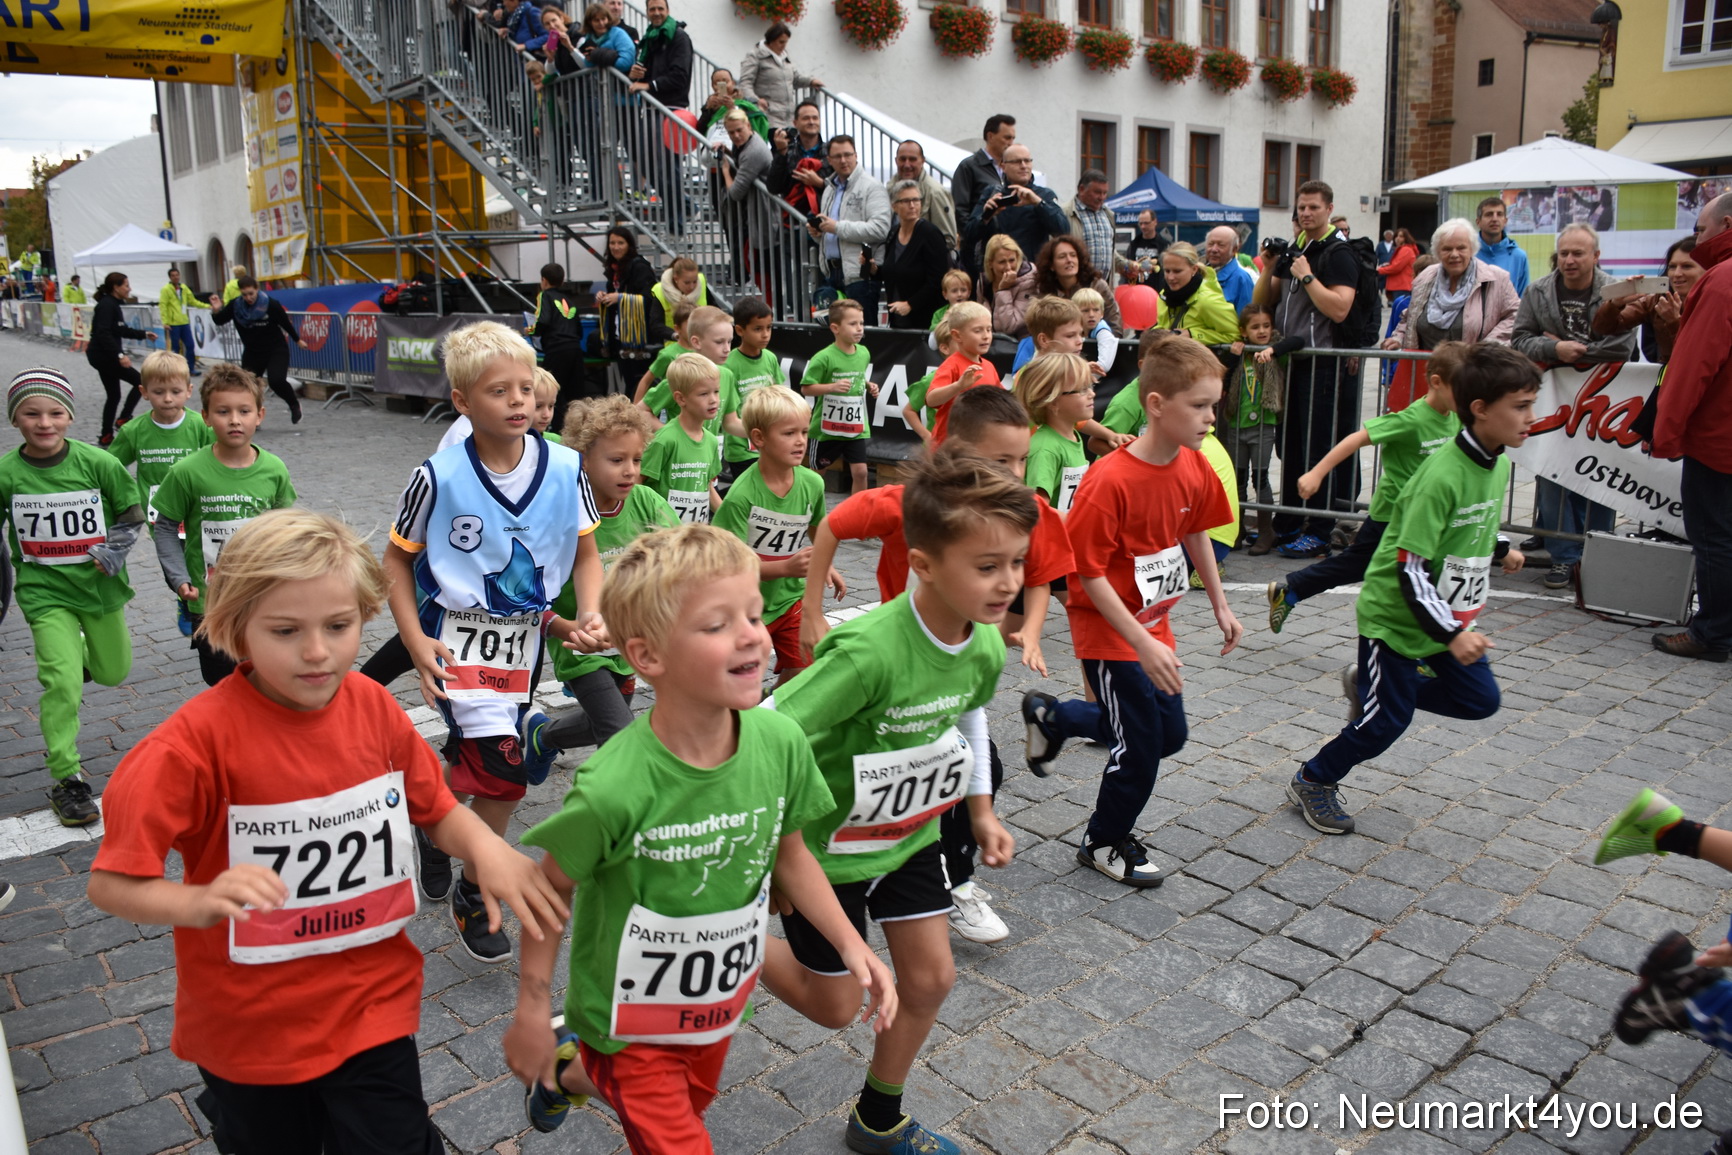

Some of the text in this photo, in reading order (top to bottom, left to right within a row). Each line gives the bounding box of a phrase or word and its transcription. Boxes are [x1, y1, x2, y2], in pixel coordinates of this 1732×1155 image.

[137, 17, 254, 33] Neumarkter Stadtlauf
[388, 339, 435, 362] BOCK
[827, 404, 862, 422] 7184
[139, 447, 184, 456] Neumarkter
[141, 456, 175, 464] Stadtlauf
[671, 461, 708, 470] Neumarkter
[14, 498, 88, 509] PARTL Neumarkt
[200, 493, 253, 504] Neumarkter
[201, 502, 242, 513] Stadtlauf
[669, 495, 693, 504] PARTL
[22, 507, 98, 538] 7108
[750, 512, 779, 526] PARTL
[203, 527, 230, 536] PARTL
[448, 514, 484, 554] 8
[37, 543, 89, 555] Jonathan
[1135, 560, 1168, 575] PARTL
[447, 609, 530, 627] PARTL Neumarkt
[455, 626, 528, 665] 7011
[478, 670, 511, 691] Simon
[859, 763, 905, 783] PARTL
[866, 758, 965, 823] 7015
[234, 798, 381, 836] PARTL Neumarkt
[252, 818, 394, 899] 7221
[294, 907, 366, 938] Julius
[628, 922, 691, 944] PARTL
[678, 1007, 733, 1030] Felix
